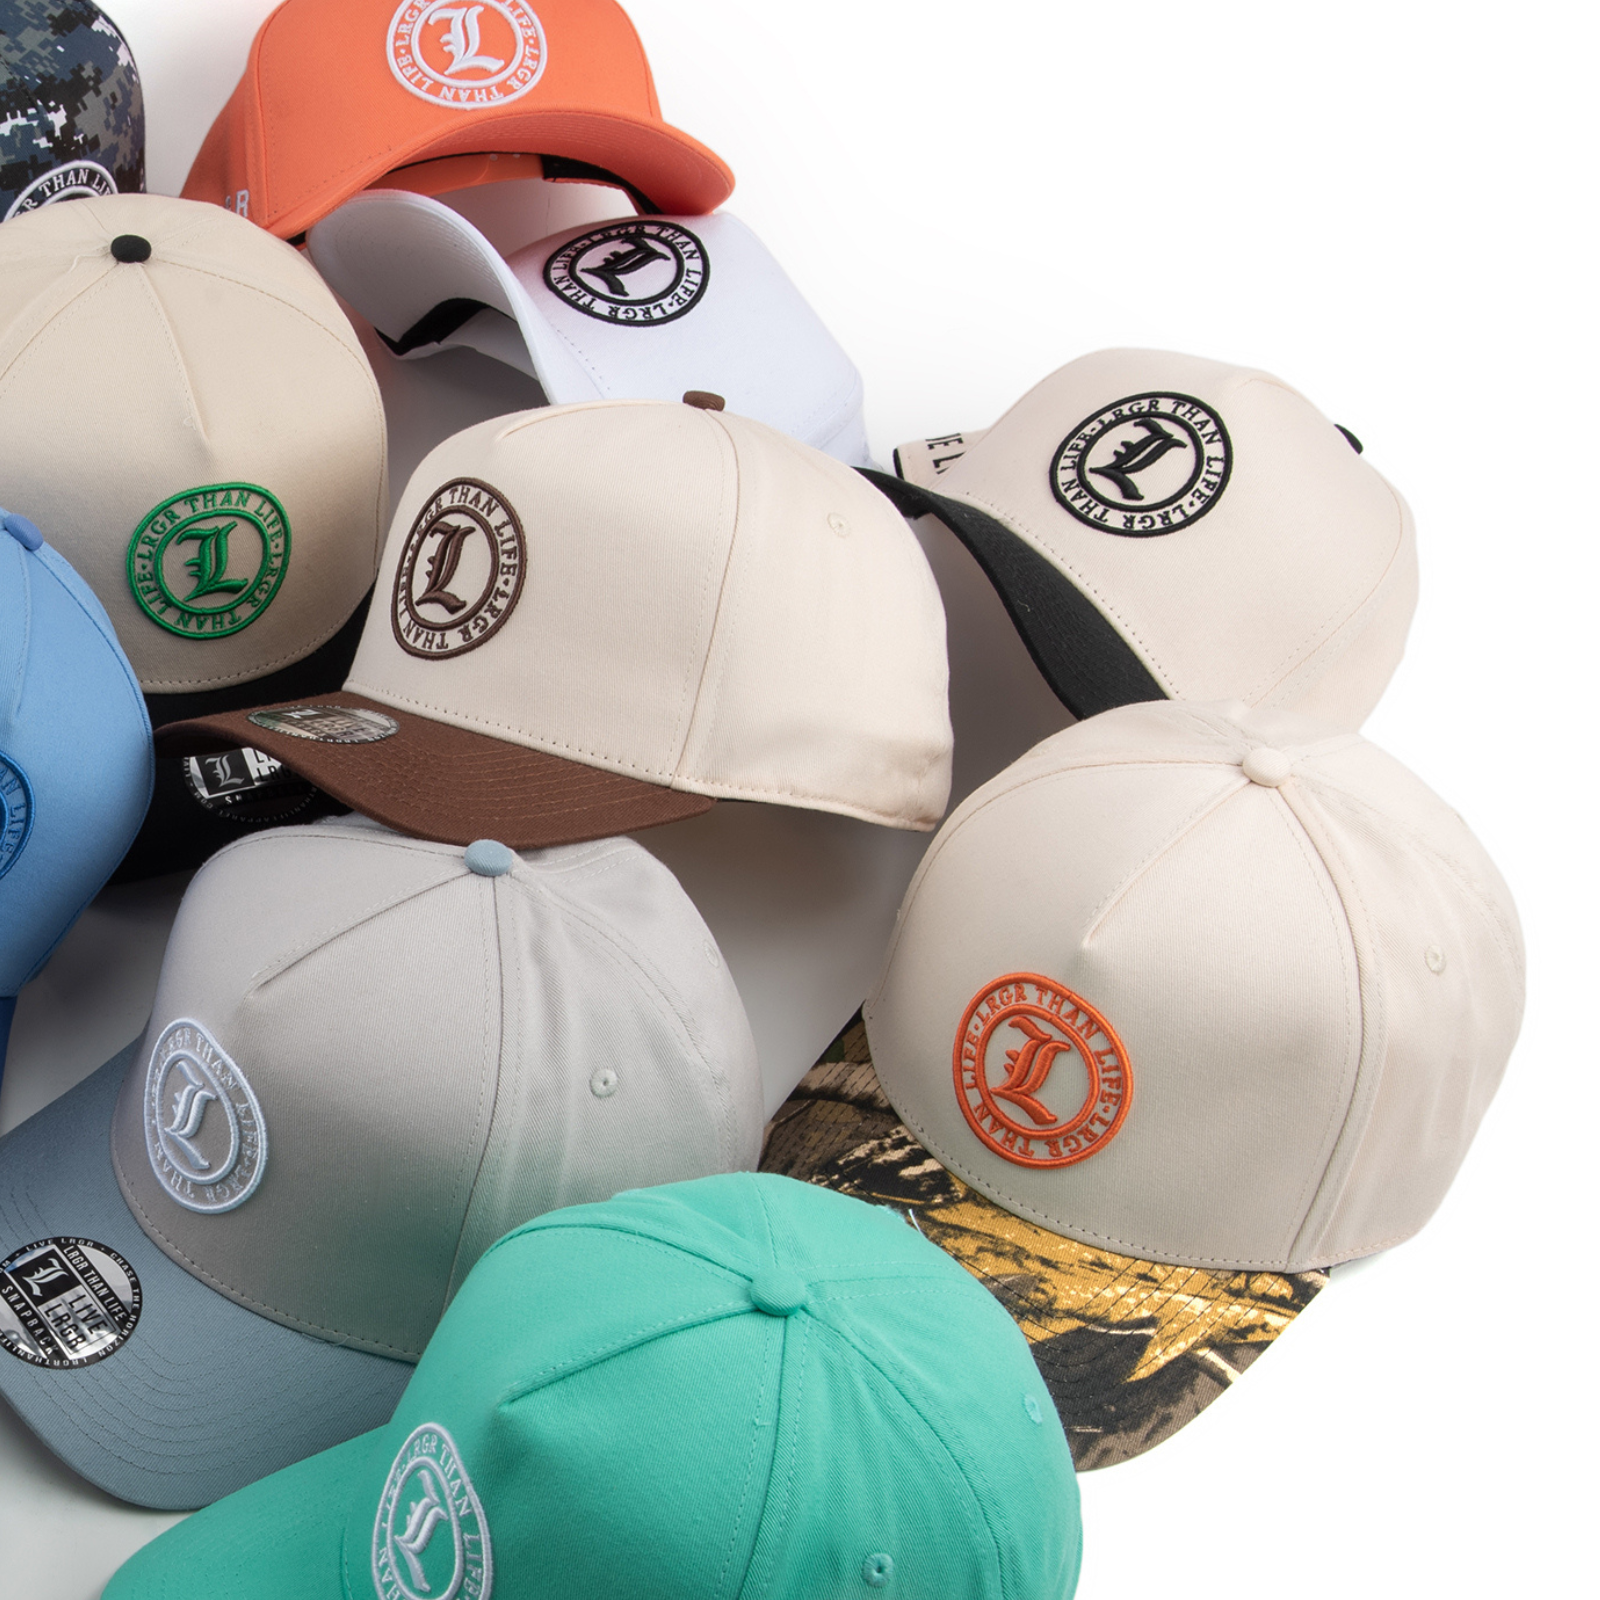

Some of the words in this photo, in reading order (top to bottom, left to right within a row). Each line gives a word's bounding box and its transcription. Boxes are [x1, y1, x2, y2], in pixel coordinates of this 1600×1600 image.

[428, 5, 505, 76] L
[397, 54, 434, 91] LIFE
[506, 45, 539, 90] LRGR
[439, 86, 504, 102] THAN
[38, 168, 90, 198] THAN
[656, 226, 701, 261] THAN
[553, 275, 598, 311] THAN
[670, 268, 702, 306] LIFE
[608, 304, 668, 320] LRGR
[1098, 399, 1160, 427] LRGR
[1171, 400, 1222, 446] THAN
[1060, 432, 1092, 471] LIFE
[1089, 417, 1188, 501] L
[184, 491, 252, 513] THAN
[449, 485, 499, 518] THAN
[1061, 478, 1111, 523] THAN
[1191, 455, 1224, 505] LIFE
[137, 509, 181, 561] LRGR
[254, 500, 283, 542] LIFE
[1122, 504, 1190, 529] LRGR
[176, 521, 249, 602] L
[415, 521, 477, 615] L
[494, 518, 518, 576] LIFE
[137, 572, 173, 615] LIFE
[246, 552, 282, 608] LRGR
[174, 610, 242, 630] THAN
[402, 619, 449, 650] THAN
[457, 587, 510, 643] LRGR
[205, 754, 245, 788] L
[257, 764, 298, 781] LRG
[2, 802, 26, 854] LIFE
[976, 983, 1028, 1024] LRGR
[1035, 985, 1100, 1040] THAN
[196, 1032, 241, 1091] THAN
[963, 1029, 979, 1090] LIFE
[989, 1016, 1071, 1125] L
[1094, 1048, 1122, 1106] LIFE
[973, 1102, 1035, 1158] THAN
[1045, 1112, 1111, 1158] LRGR
[25, 1239, 55, 1252] LIVE
[60, 1237, 94, 1248] LRGR
[22, 1257, 69, 1297] L
[63, 1245, 89, 1271] LRGR
[84, 1269, 110, 1297] THAN
[103, 1295, 128, 1321] LIFE
[110, 1252, 137, 1283] CHASE
[1, 1285, 59, 1355] SNAPBACK
[69, 1294, 108, 1335] LIVE
[132, 1287, 140, 1310] THE
[43, 1303, 87, 1350] LRGR
[98, 1315, 137, 1358] HORIZON
[439, 1443, 473, 1517] THAN
[378, 1547, 401, 1600] HAN
[463, 1532, 483, 1596] LIFE
